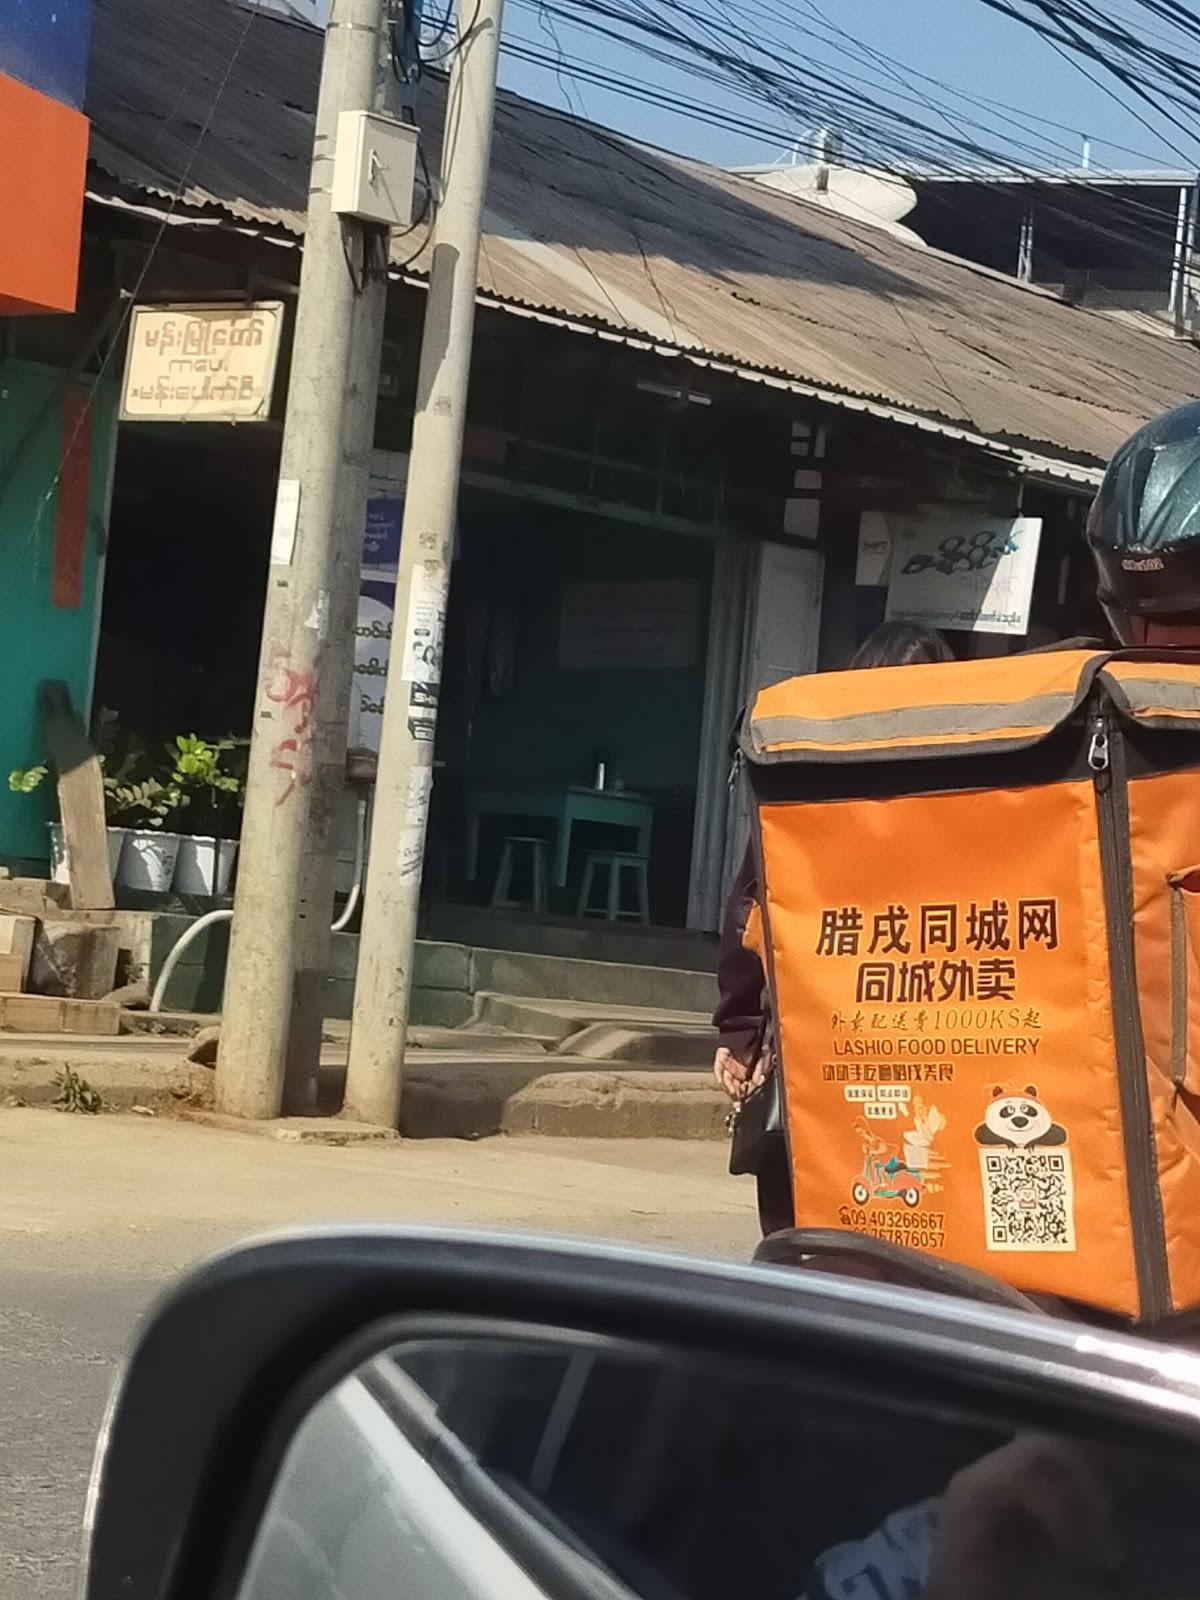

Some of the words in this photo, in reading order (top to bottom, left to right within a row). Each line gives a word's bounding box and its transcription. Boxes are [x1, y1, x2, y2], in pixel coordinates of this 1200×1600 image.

[815, 898, 1059, 957] 腊戌同城网
[855, 958, 1016, 1003] 同城外卖
[833, 1038, 894, 1056] LASHIO
[898, 1038, 946, 1055] FOOD
[951, 1037, 1041, 1055] DELIVERY
